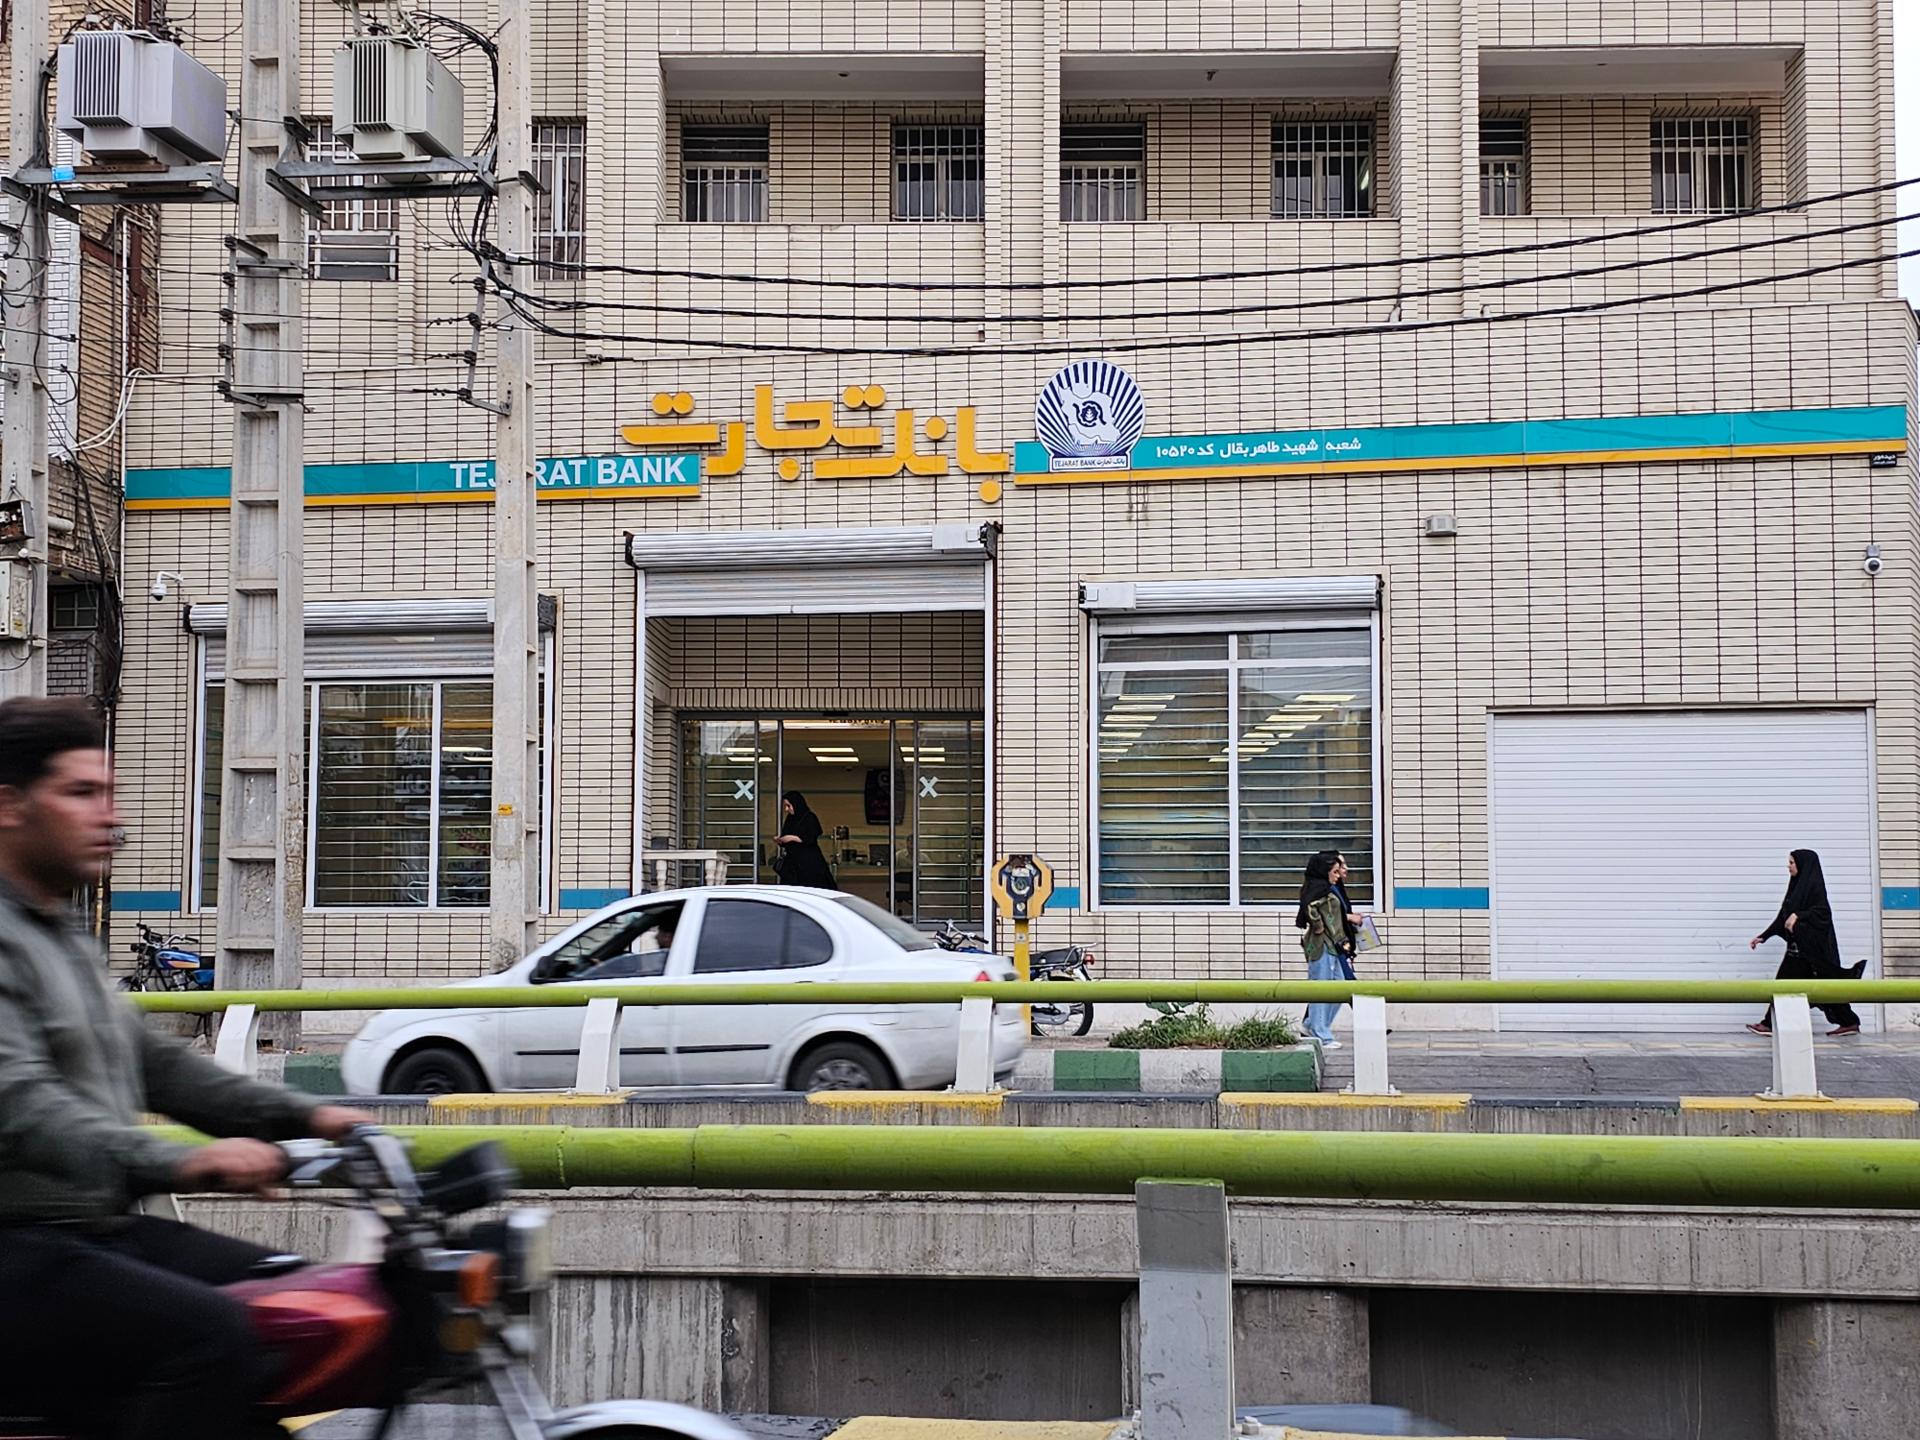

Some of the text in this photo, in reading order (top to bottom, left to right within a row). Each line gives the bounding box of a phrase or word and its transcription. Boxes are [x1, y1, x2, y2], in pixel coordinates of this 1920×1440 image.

[621, 384, 1009, 504] بانک تجارت
[1196, 443, 1215, 456] کد
[1281, 438, 1319, 455] شهید
[1325, 437, 1362, 454] شعبه
[1080, 459, 1096, 467] BANK
[449, 457, 686, 488] TERAT BANK
